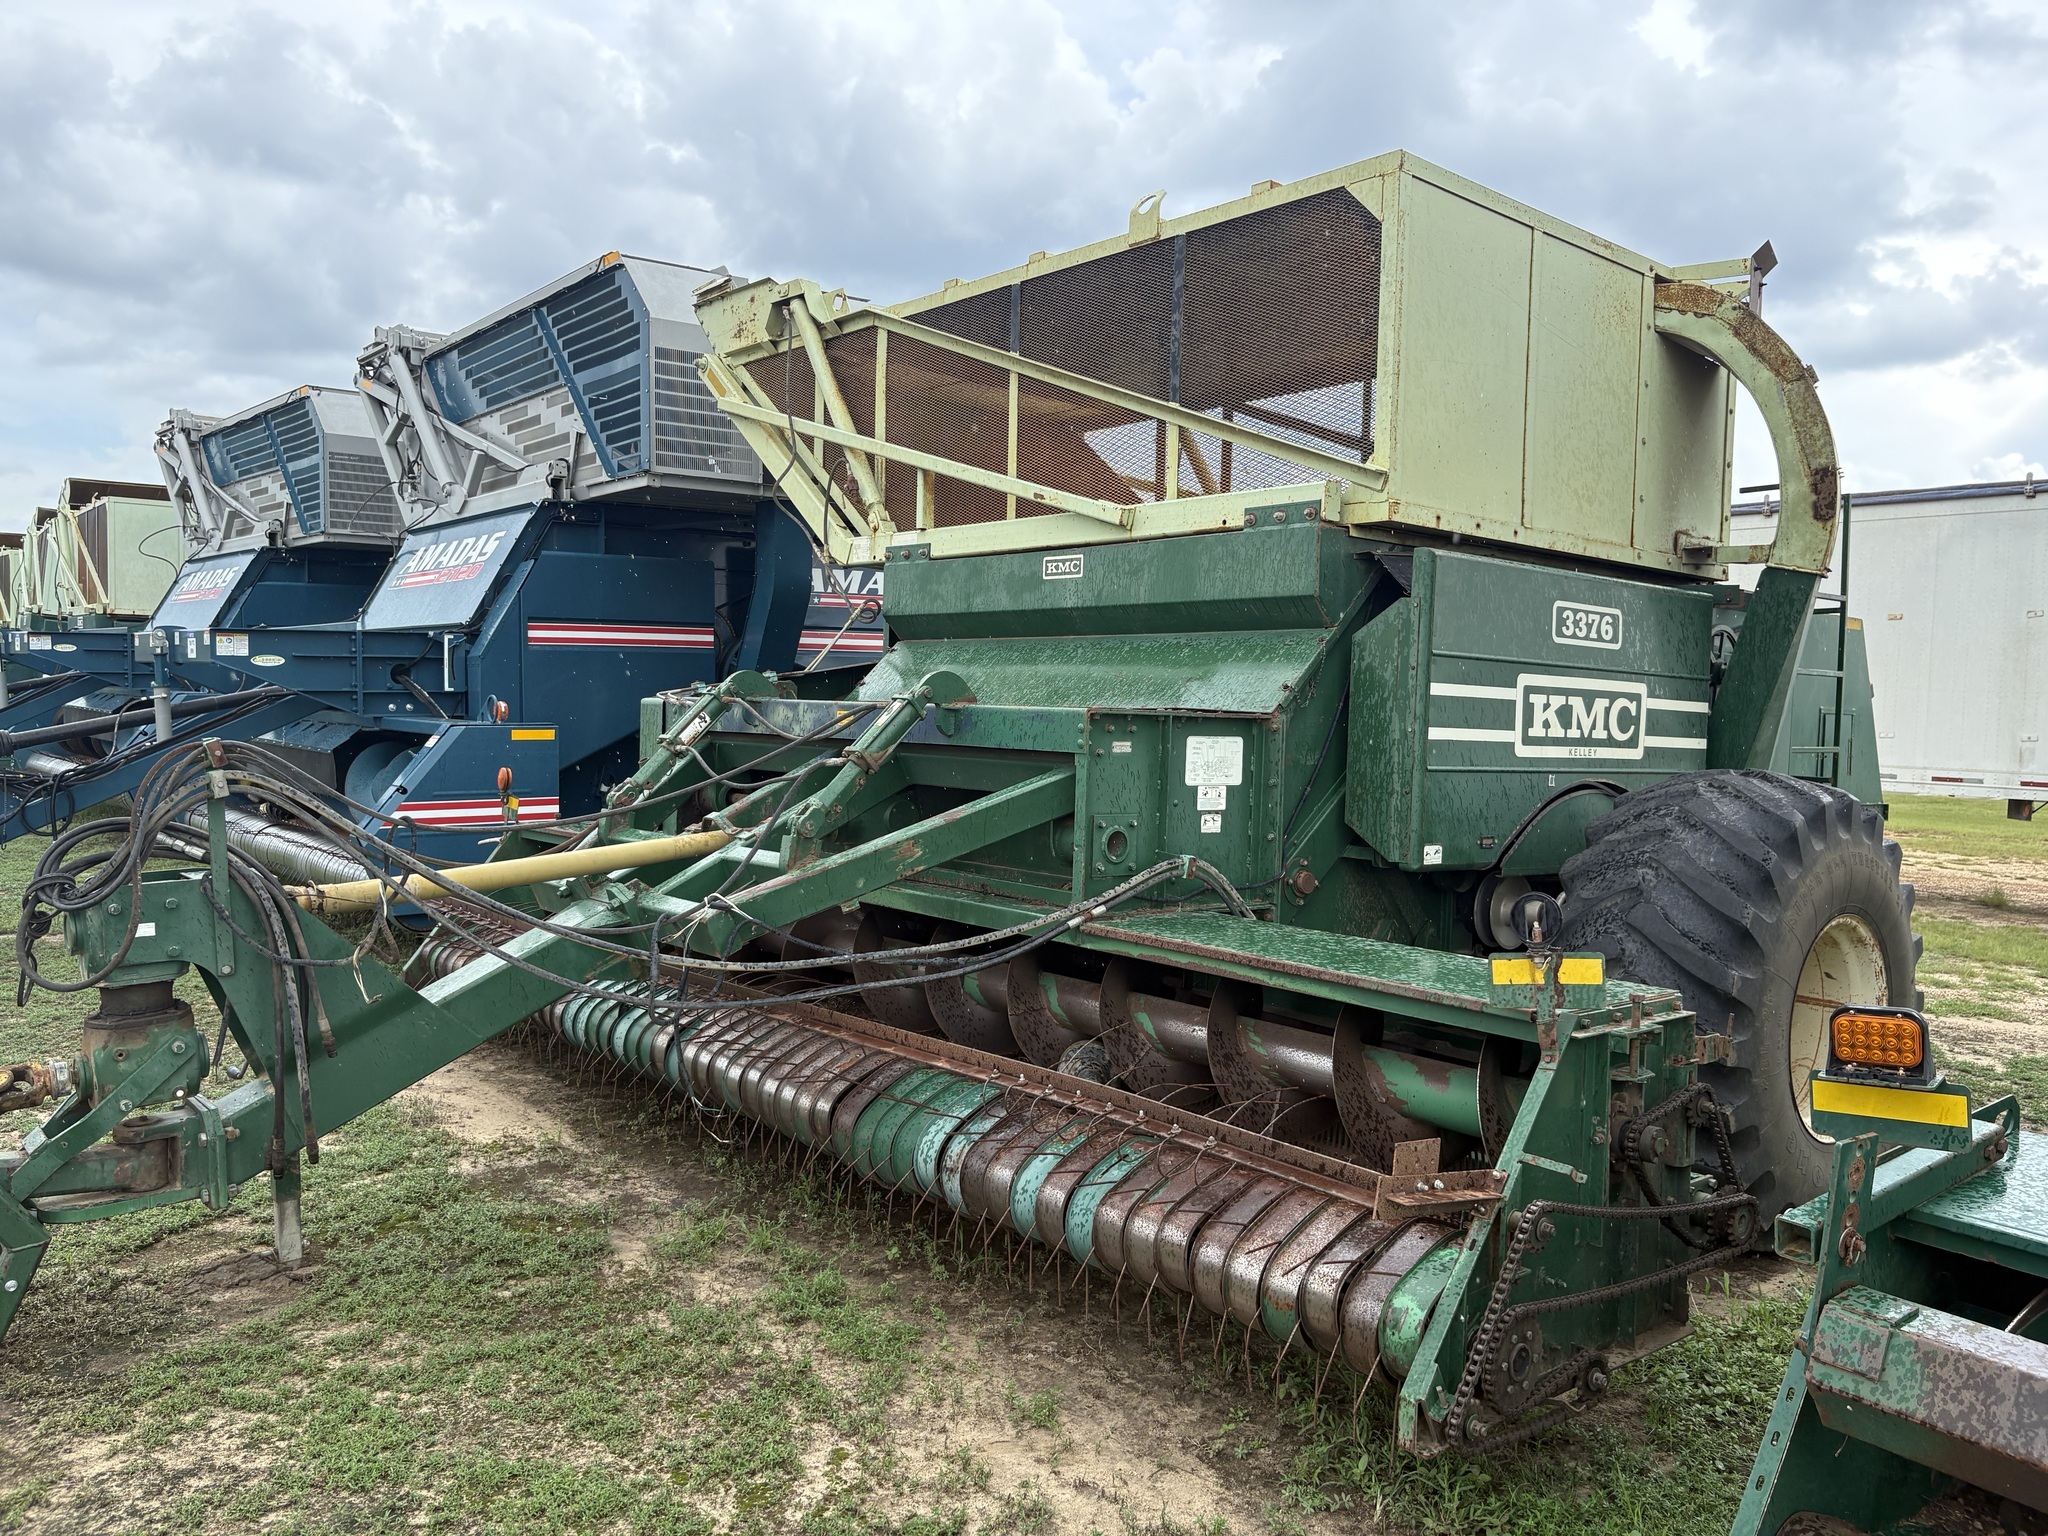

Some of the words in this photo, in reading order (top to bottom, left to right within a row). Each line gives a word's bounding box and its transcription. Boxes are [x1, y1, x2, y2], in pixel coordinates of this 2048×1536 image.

[399, 531, 507, 574] AMADAS
[177, 566, 240, 592] AMADAS
[434, 562, 485, 584] 2120
[1046, 560, 1080, 574] KMC
[1561, 609, 1613, 641] 3376
[1528, 693, 1637, 741] KMC
[1568, 748, 1598, 757] KELLEY
